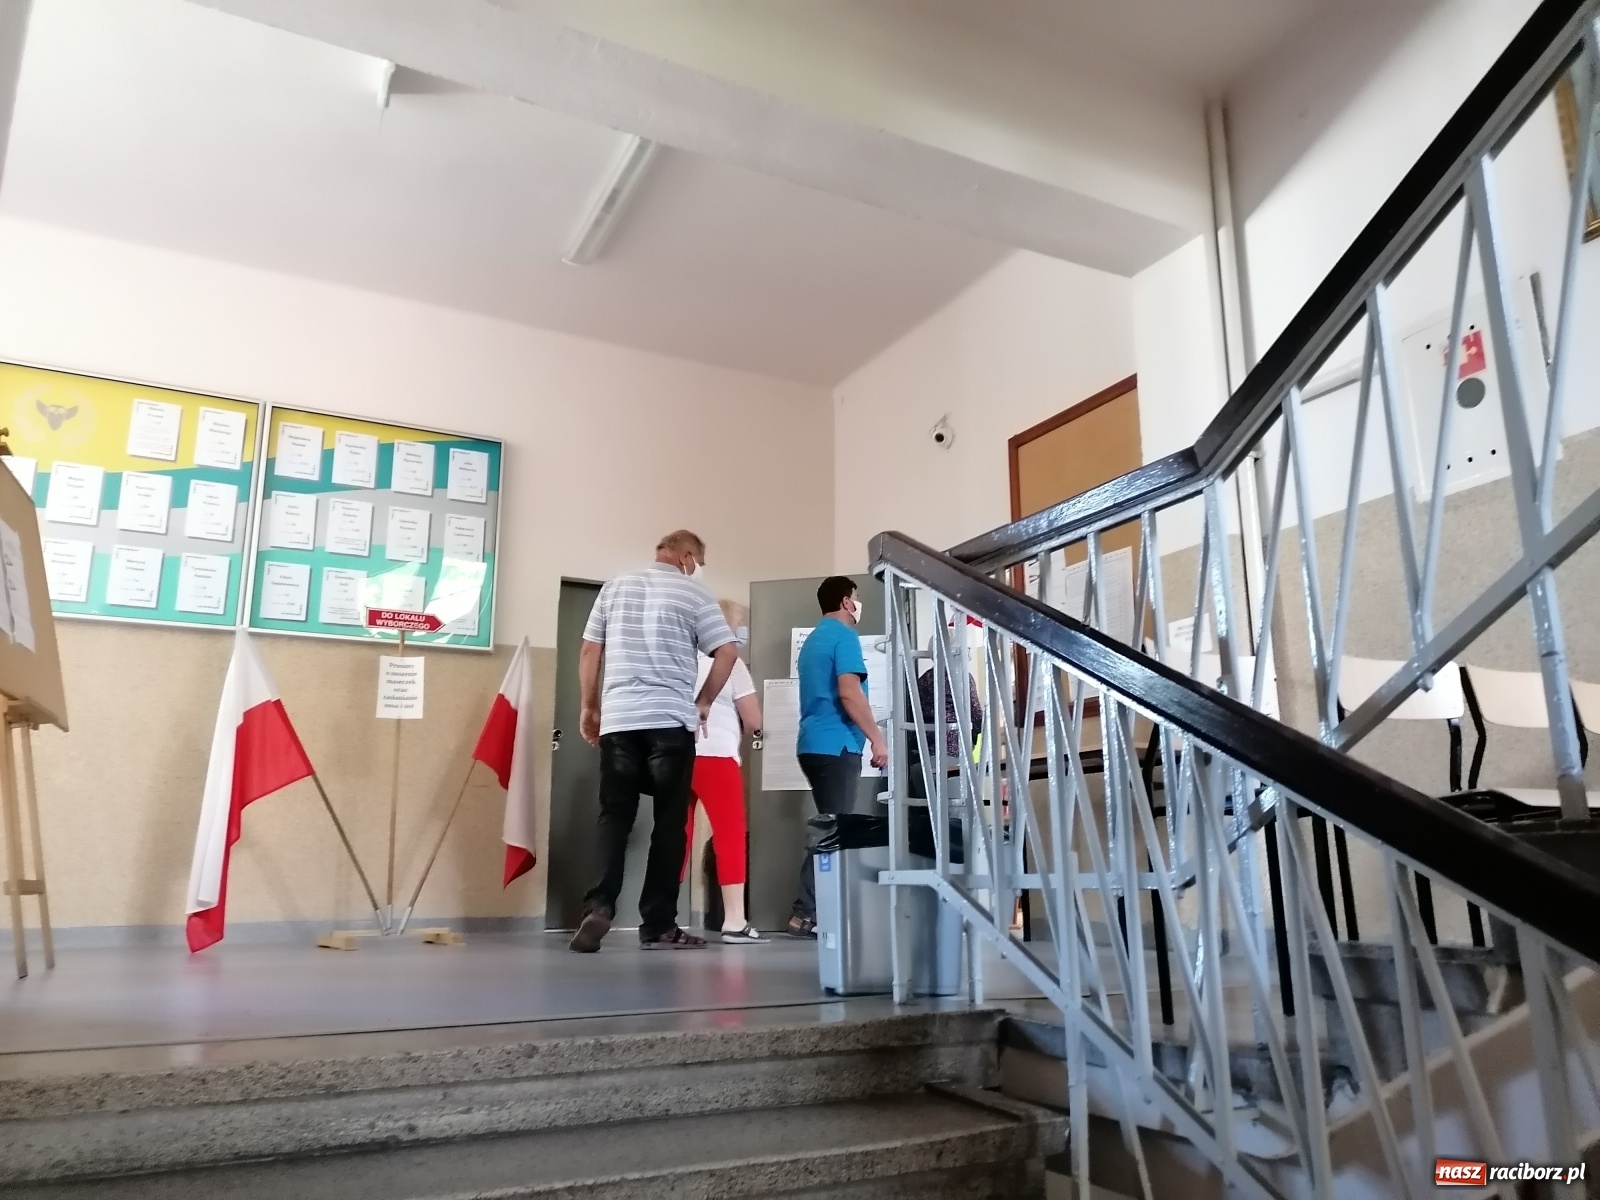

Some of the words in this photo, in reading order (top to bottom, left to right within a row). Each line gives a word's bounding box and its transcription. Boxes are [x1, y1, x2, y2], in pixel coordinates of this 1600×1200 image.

[381, 611, 393, 619] DO
[395, 613, 425, 622] LOKALU
[376, 619, 430, 630] WYBORCZEGO
